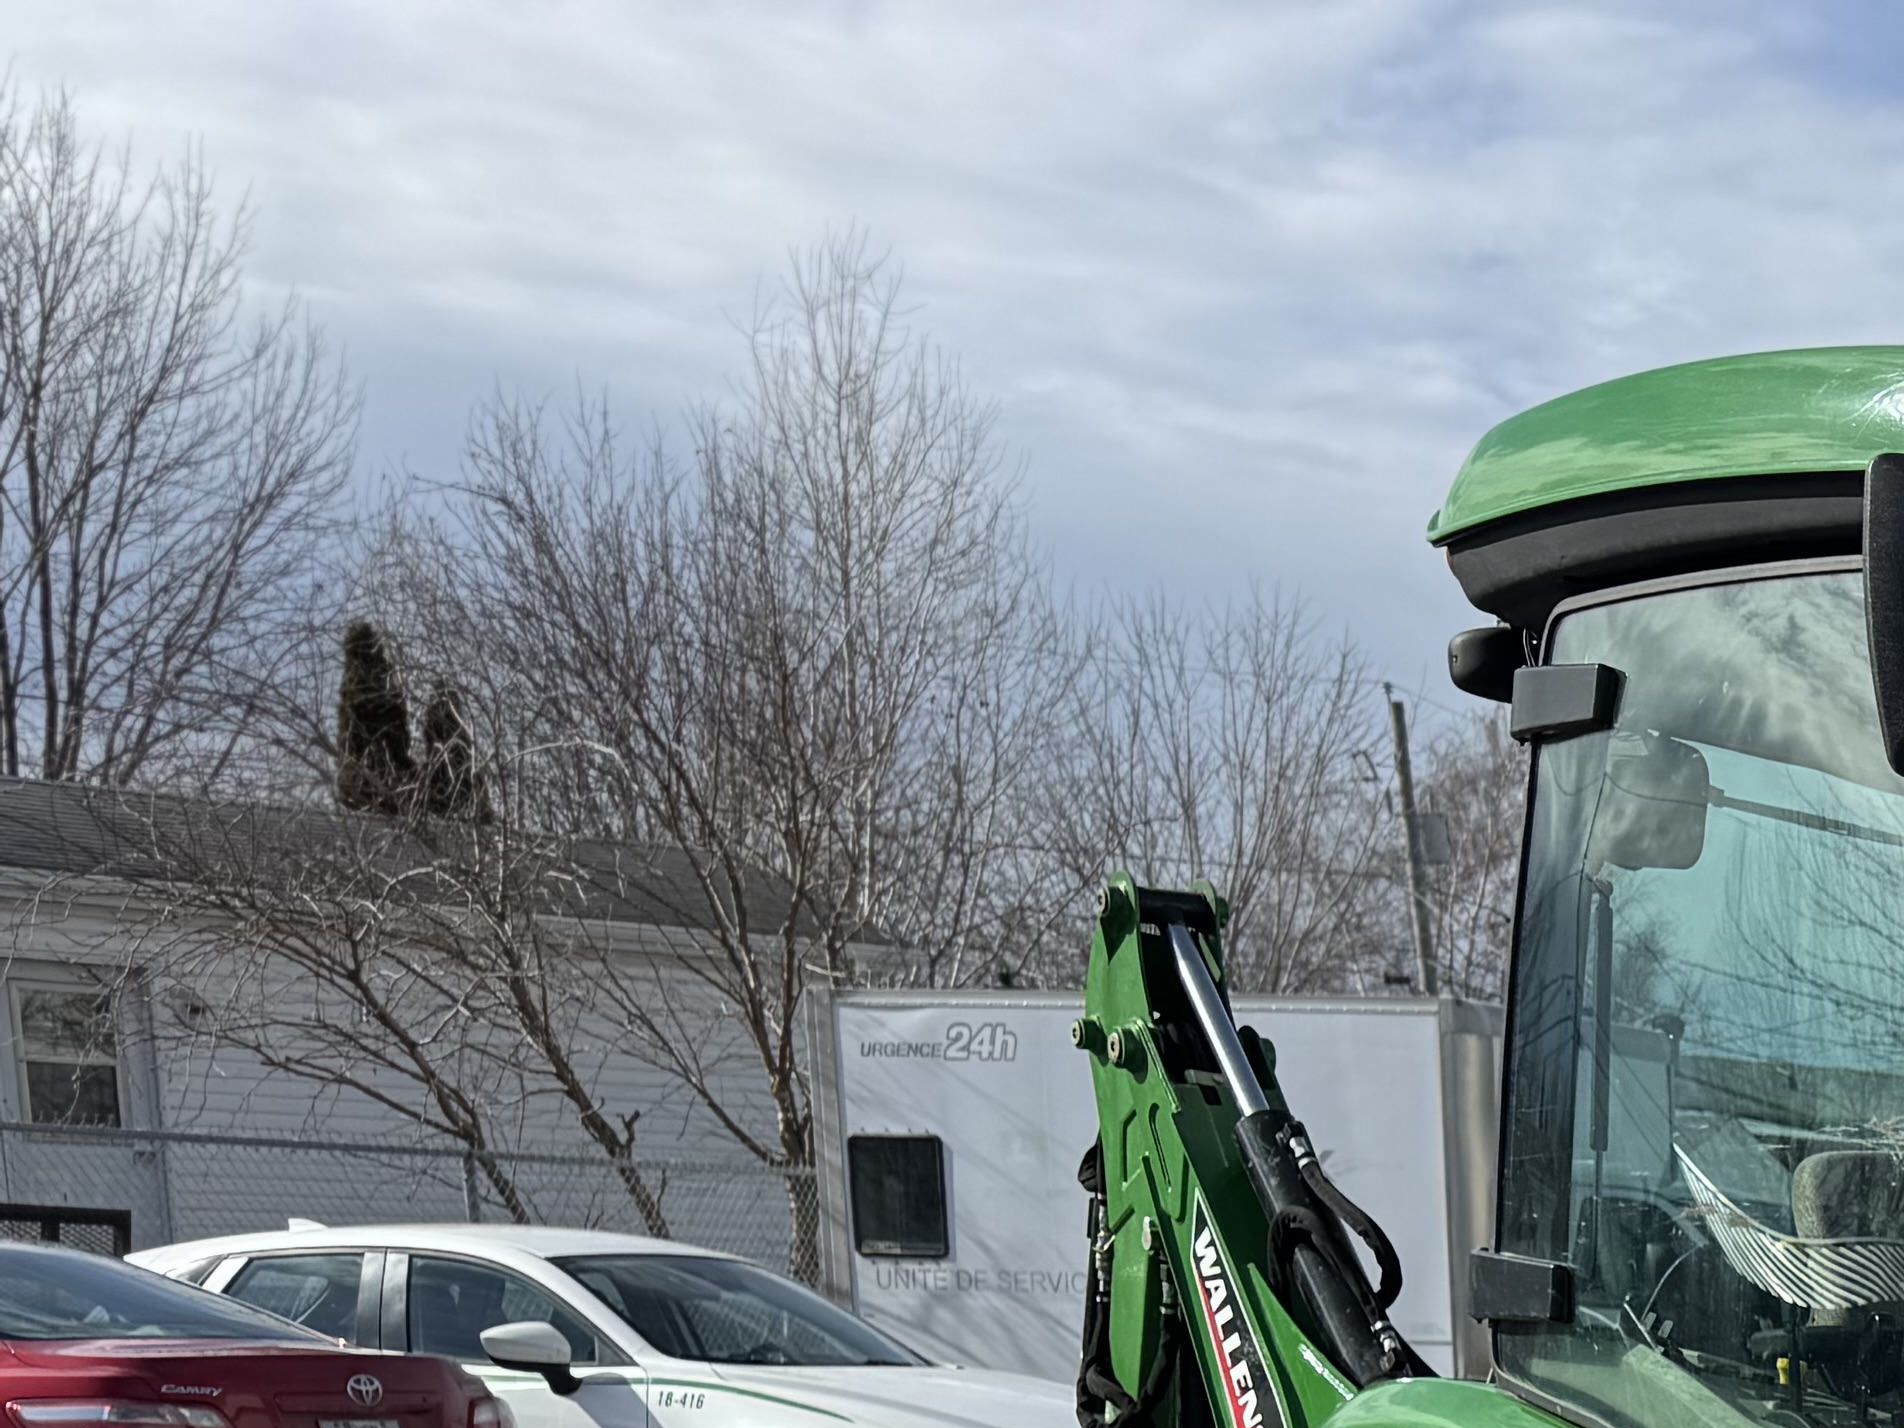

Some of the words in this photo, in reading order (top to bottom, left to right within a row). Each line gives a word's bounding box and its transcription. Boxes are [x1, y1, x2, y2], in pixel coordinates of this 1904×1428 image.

[860, 1041, 942, 1058] URGENCE
[943, 1022, 1018, 1062] 24h
[956, 1269, 987, 1291] DE
[997, 1271, 1086, 1295] SERVIC
[657, 1390, 706, 1410] 18-416
